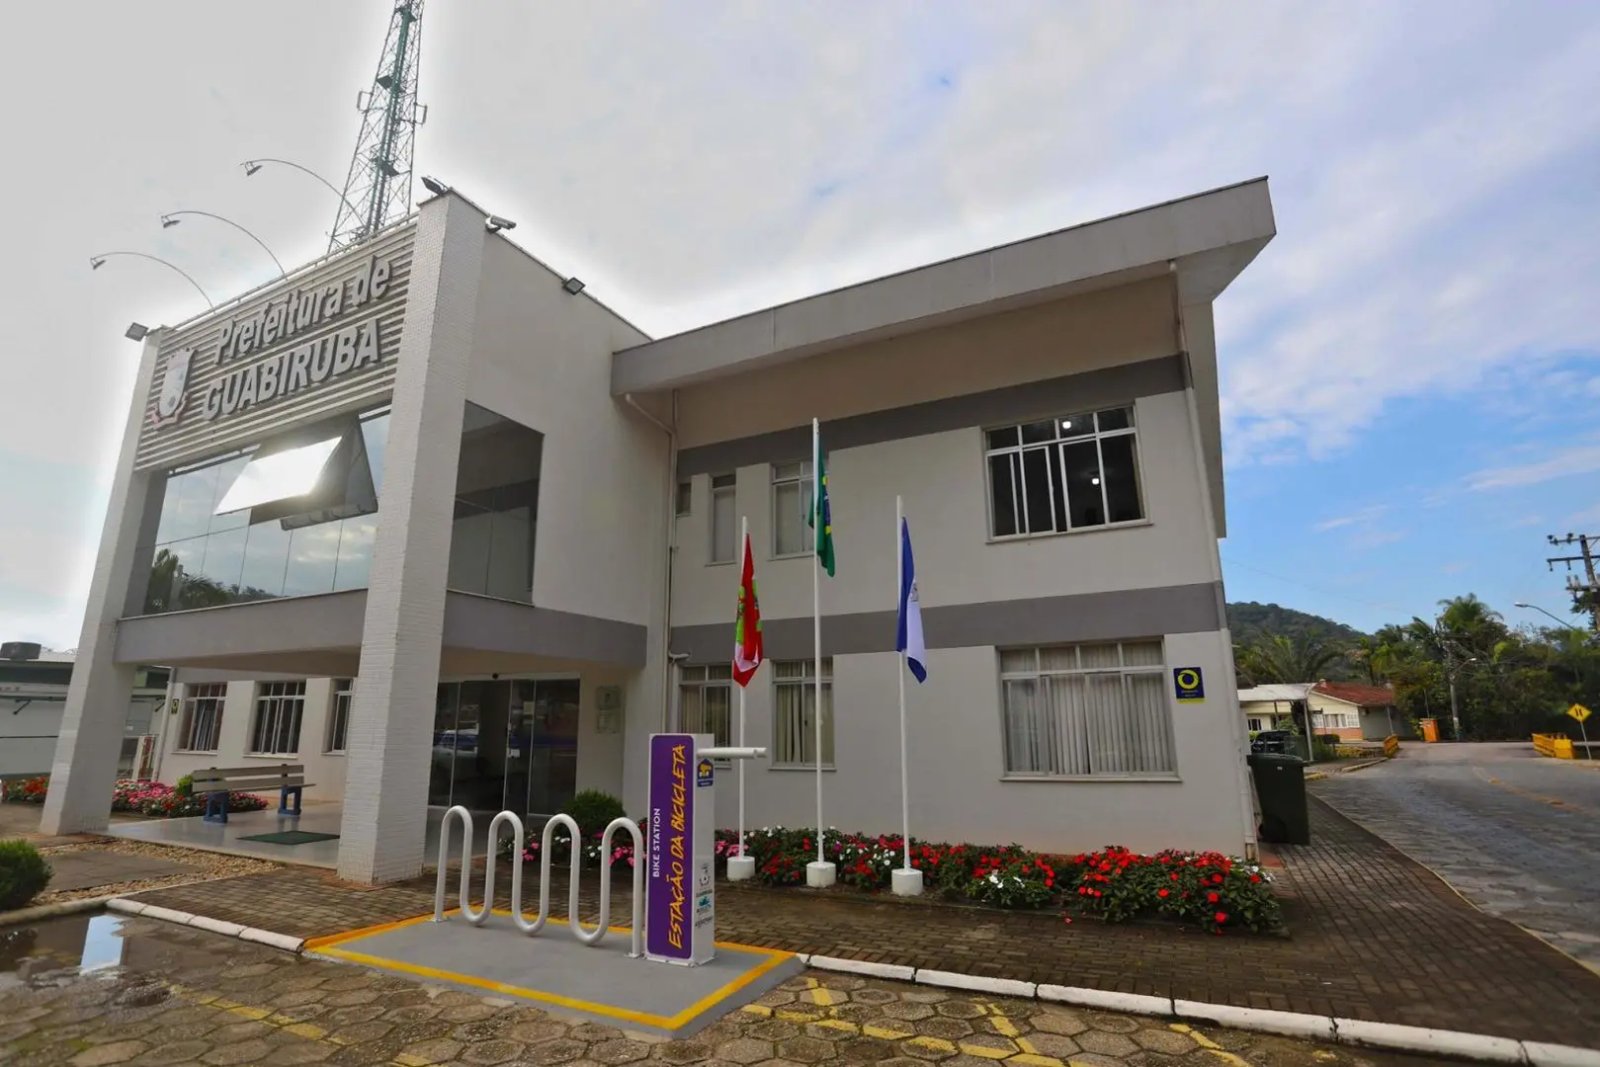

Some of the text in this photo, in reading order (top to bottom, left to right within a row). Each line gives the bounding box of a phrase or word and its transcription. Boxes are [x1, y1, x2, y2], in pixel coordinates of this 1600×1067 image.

[212, 254, 392, 366] Prefeitura de
[200, 318, 381, 422] GUABIRUBA
[652, 808, 661, 878] BIKE STATION
[665, 743, 687, 949] ESTAÇÃO DA BICICLETA
